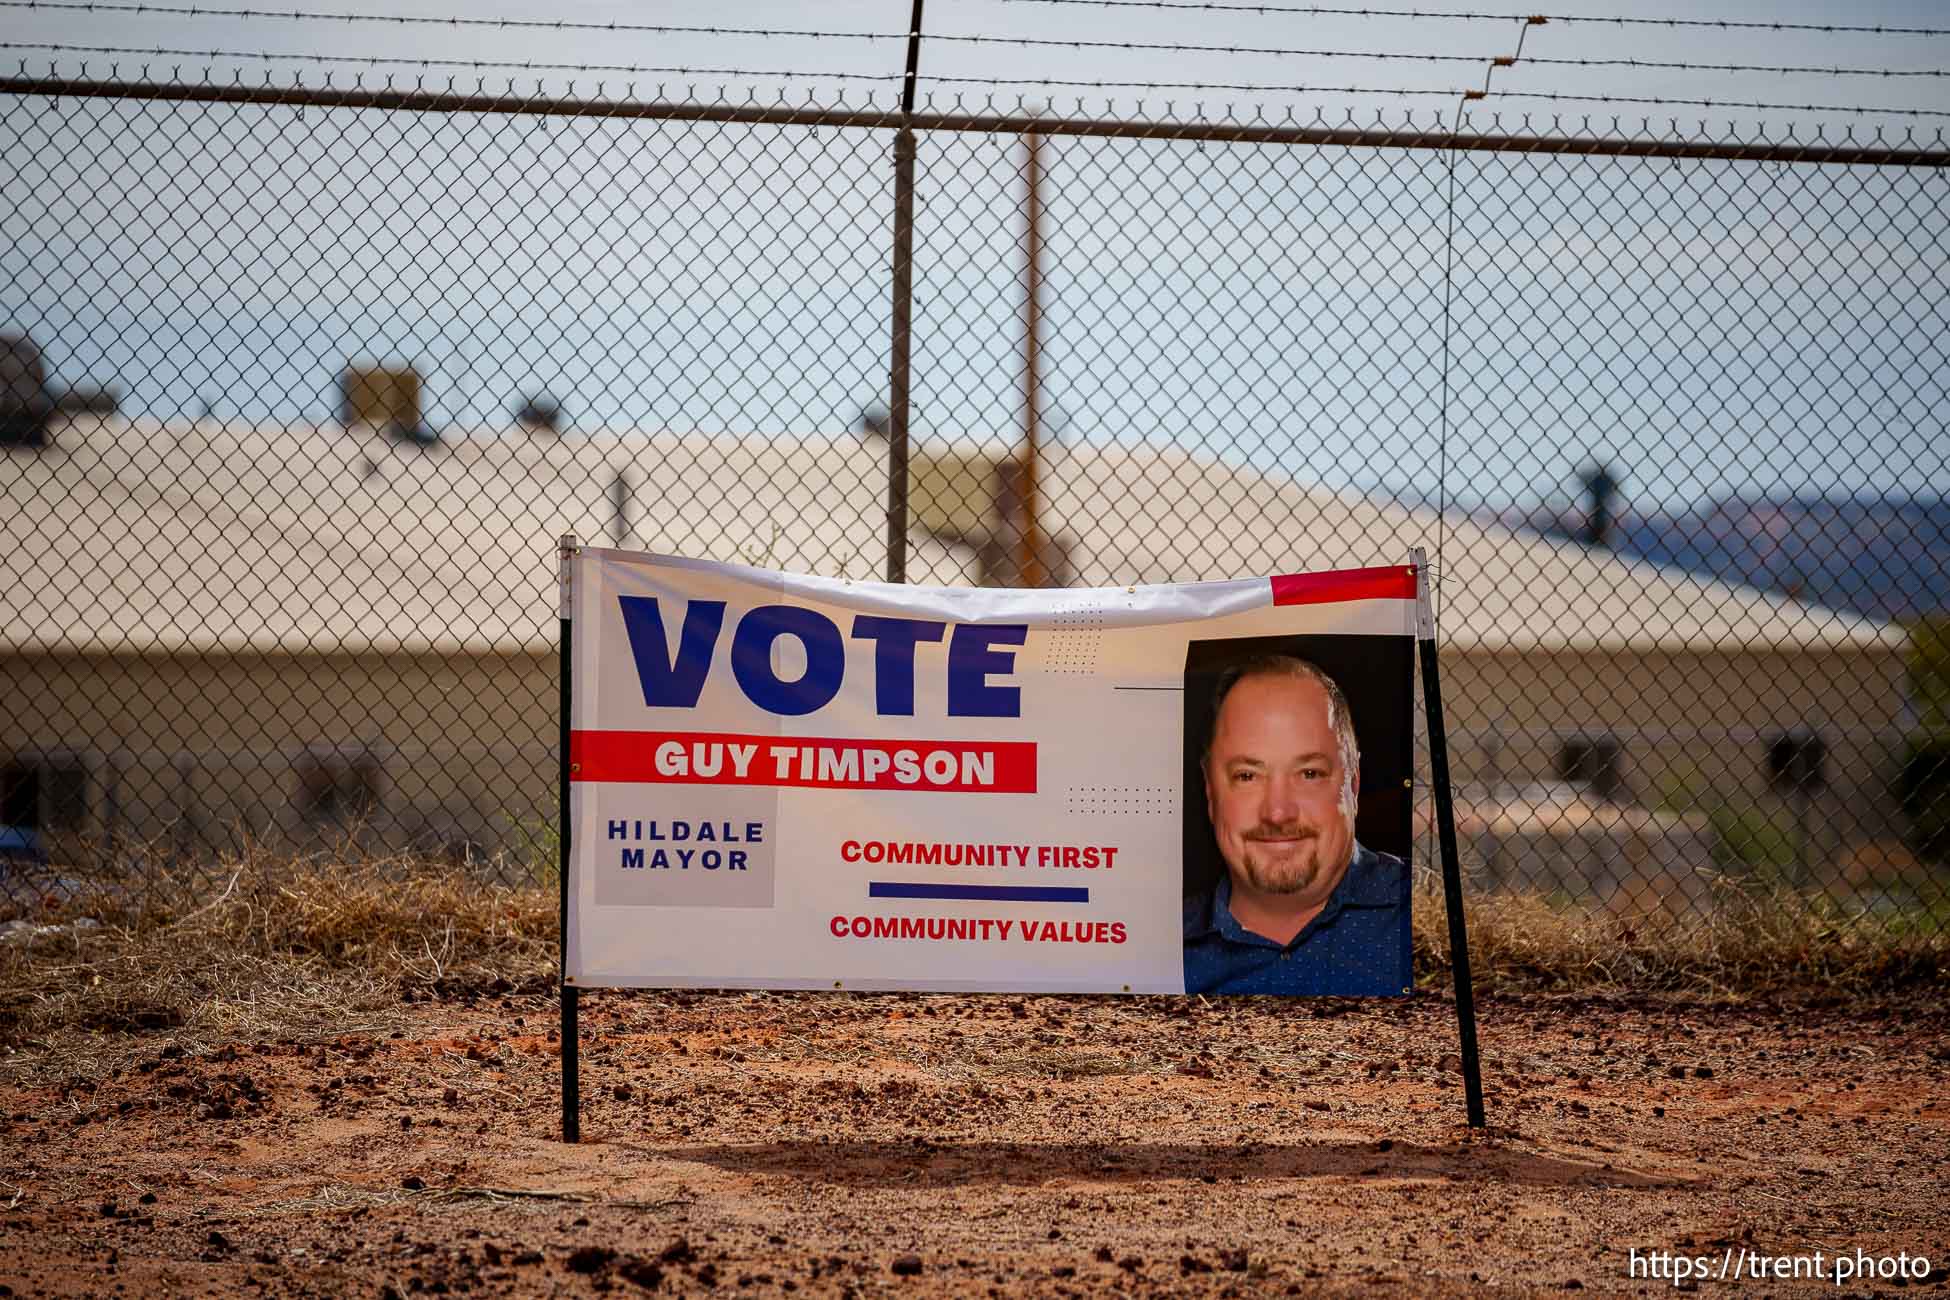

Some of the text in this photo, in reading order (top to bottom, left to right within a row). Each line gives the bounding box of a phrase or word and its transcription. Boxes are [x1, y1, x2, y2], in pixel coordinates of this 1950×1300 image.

[618, 595, 1029, 718] VOTE
[654, 741, 995, 786] GUY TIMPSON
[608, 820, 764, 843] HILDALE
[621, 848, 748, 871] MAYOR
[840, 840, 1119, 869] COMMUNITY FIRST
[829, 916, 1128, 944] COMMUNITY VALUES
